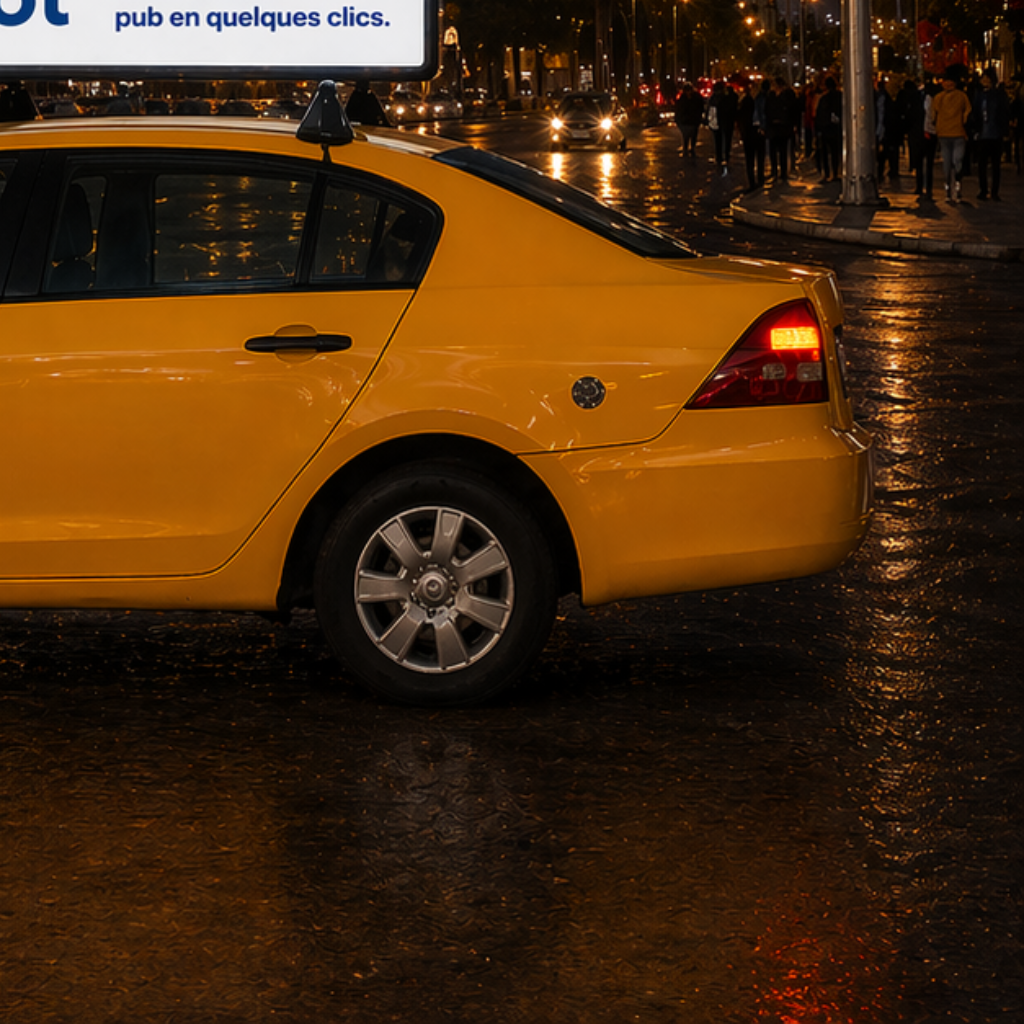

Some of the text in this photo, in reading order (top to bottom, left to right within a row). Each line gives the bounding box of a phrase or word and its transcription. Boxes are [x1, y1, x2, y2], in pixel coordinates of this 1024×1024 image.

[115, 5, 391, 33] pub en quelques clics.
